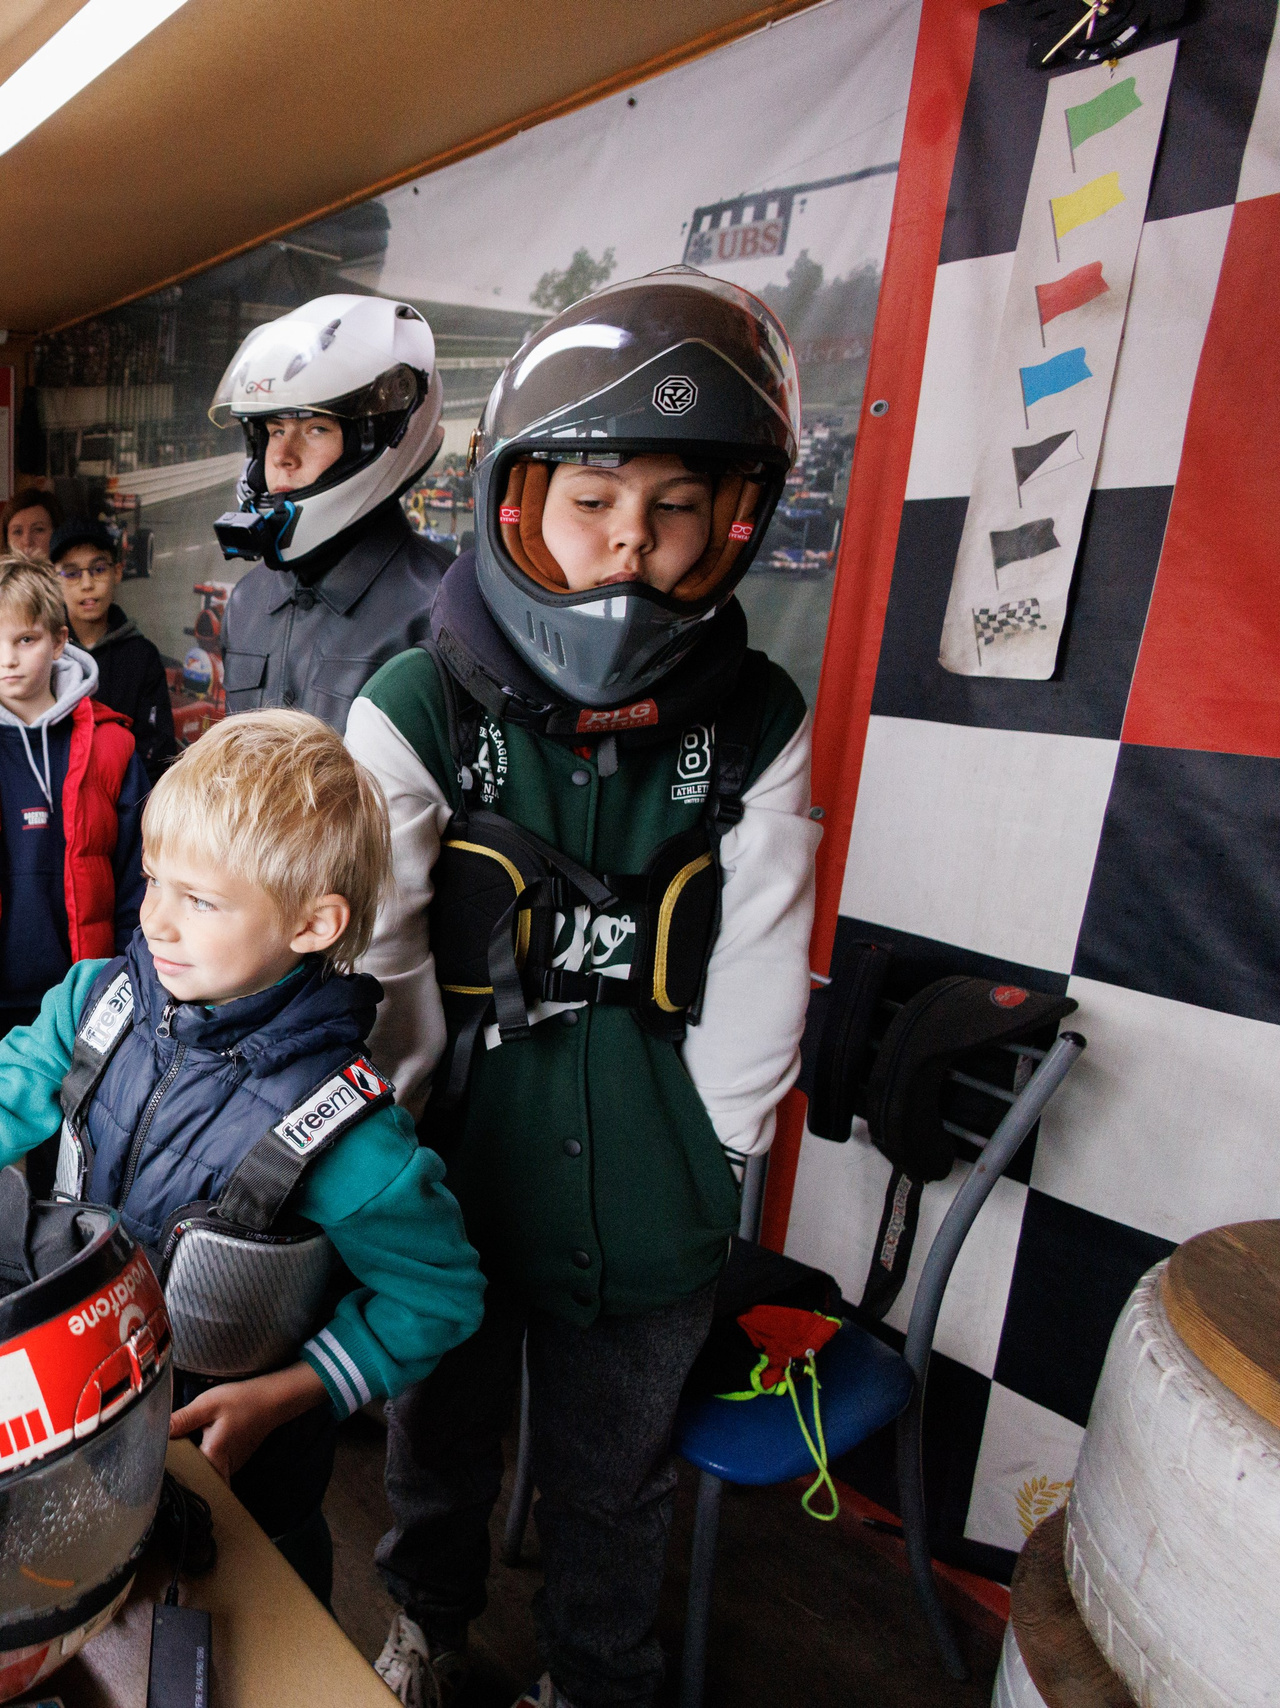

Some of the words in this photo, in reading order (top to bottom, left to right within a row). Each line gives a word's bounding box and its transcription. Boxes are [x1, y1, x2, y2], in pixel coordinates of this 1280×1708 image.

[718, 221, 780, 260] UBS
[245, 378, 276, 394] GXT
[585, 703, 651, 725] RLG
[488, 722, 508, 774] LEAGUE
[284, 1085, 355, 1148] freem
[67, 1260, 148, 1336] vodafone
